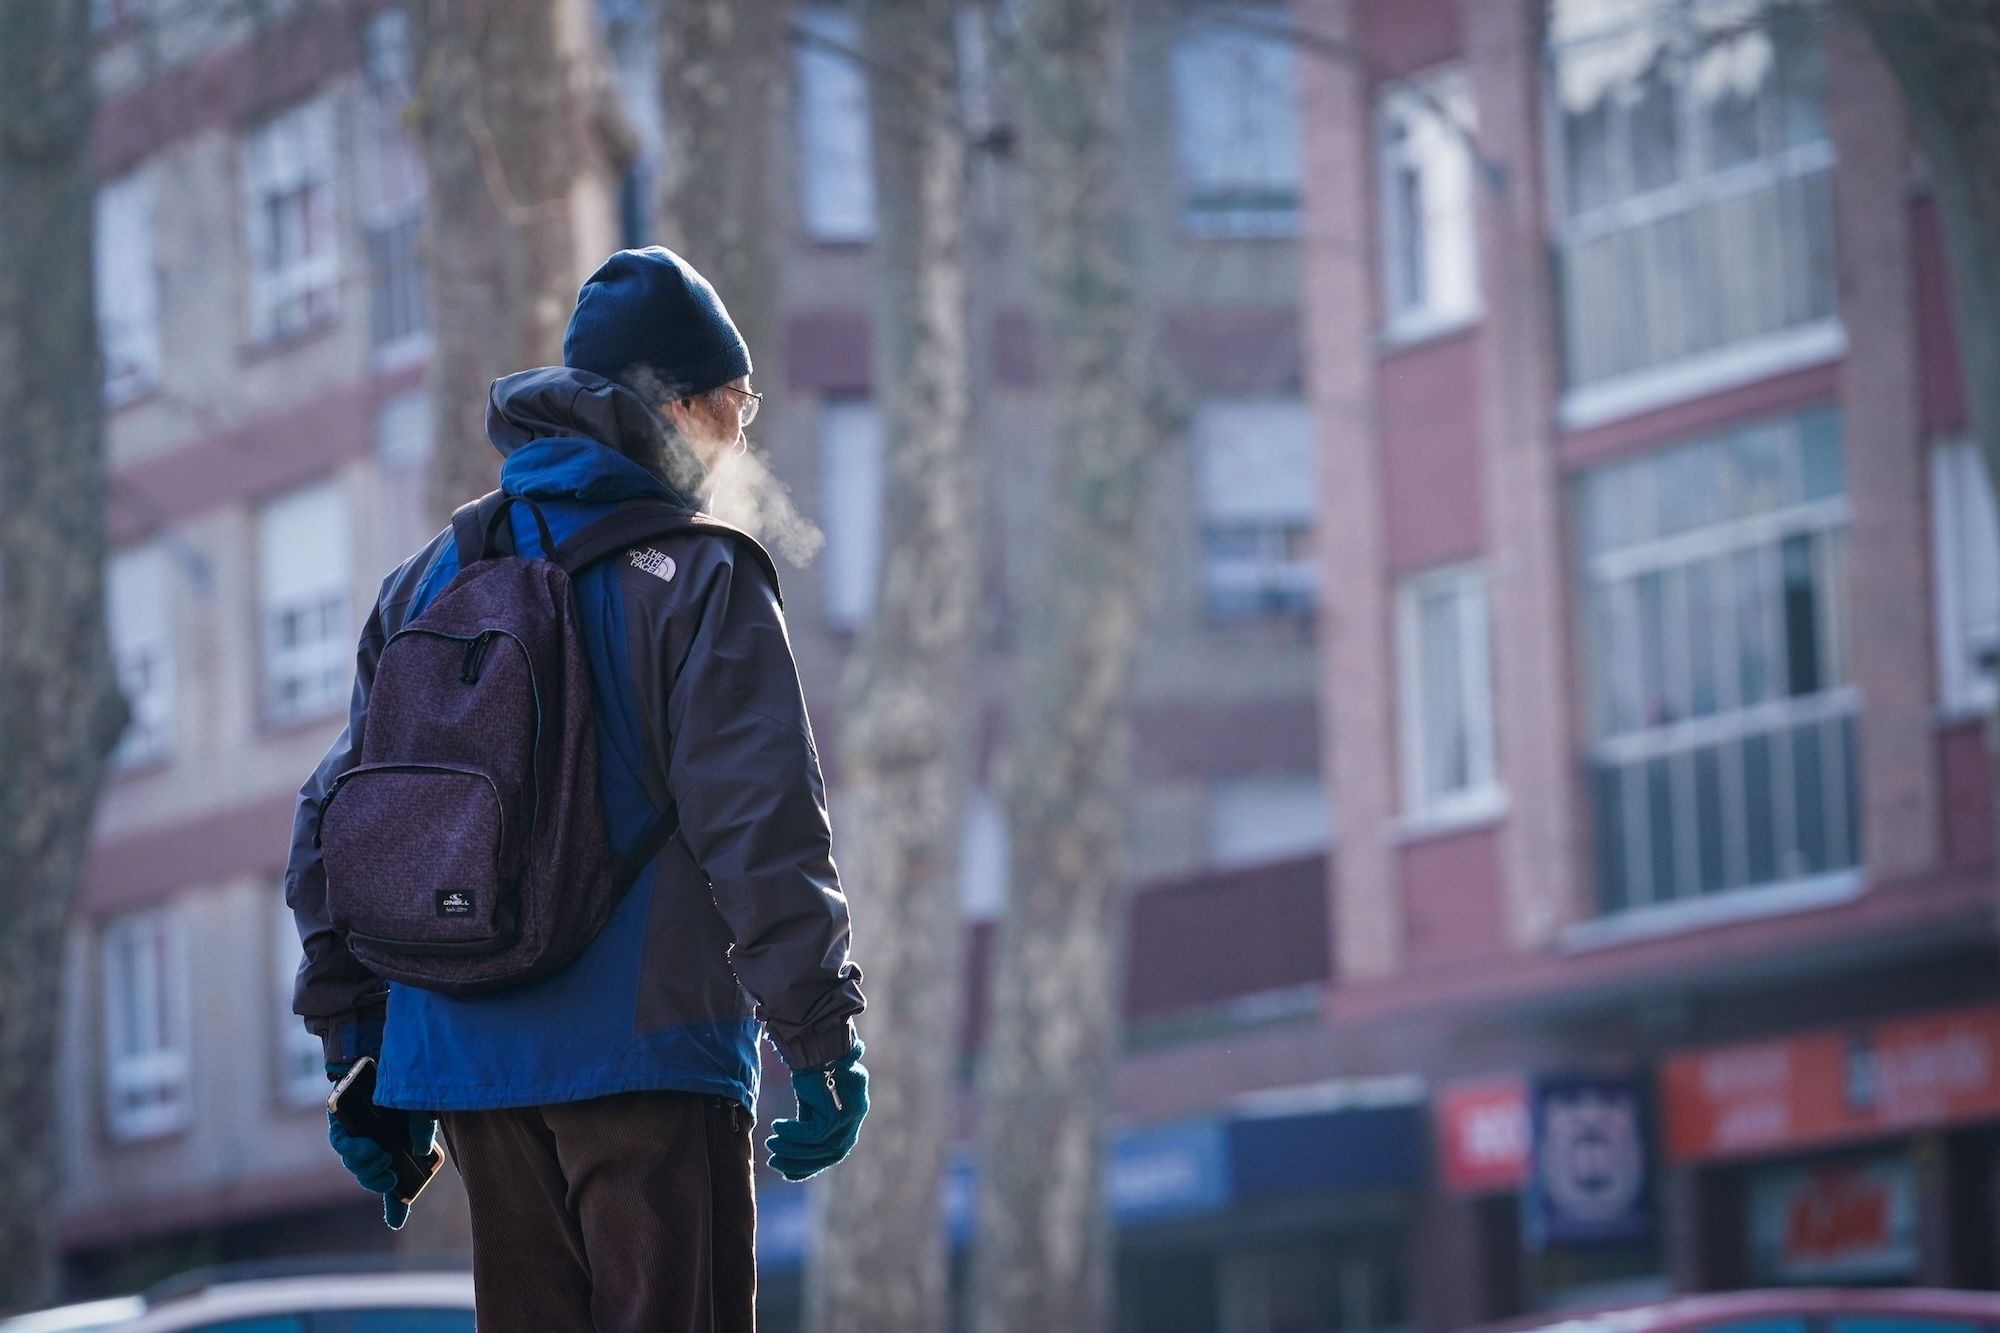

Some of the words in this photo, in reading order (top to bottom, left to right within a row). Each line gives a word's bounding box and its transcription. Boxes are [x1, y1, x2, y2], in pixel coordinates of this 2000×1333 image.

[626, 549, 662, 568] NORTH
[645, 547, 667, 560] THE
[630, 558, 657, 574] FACE
